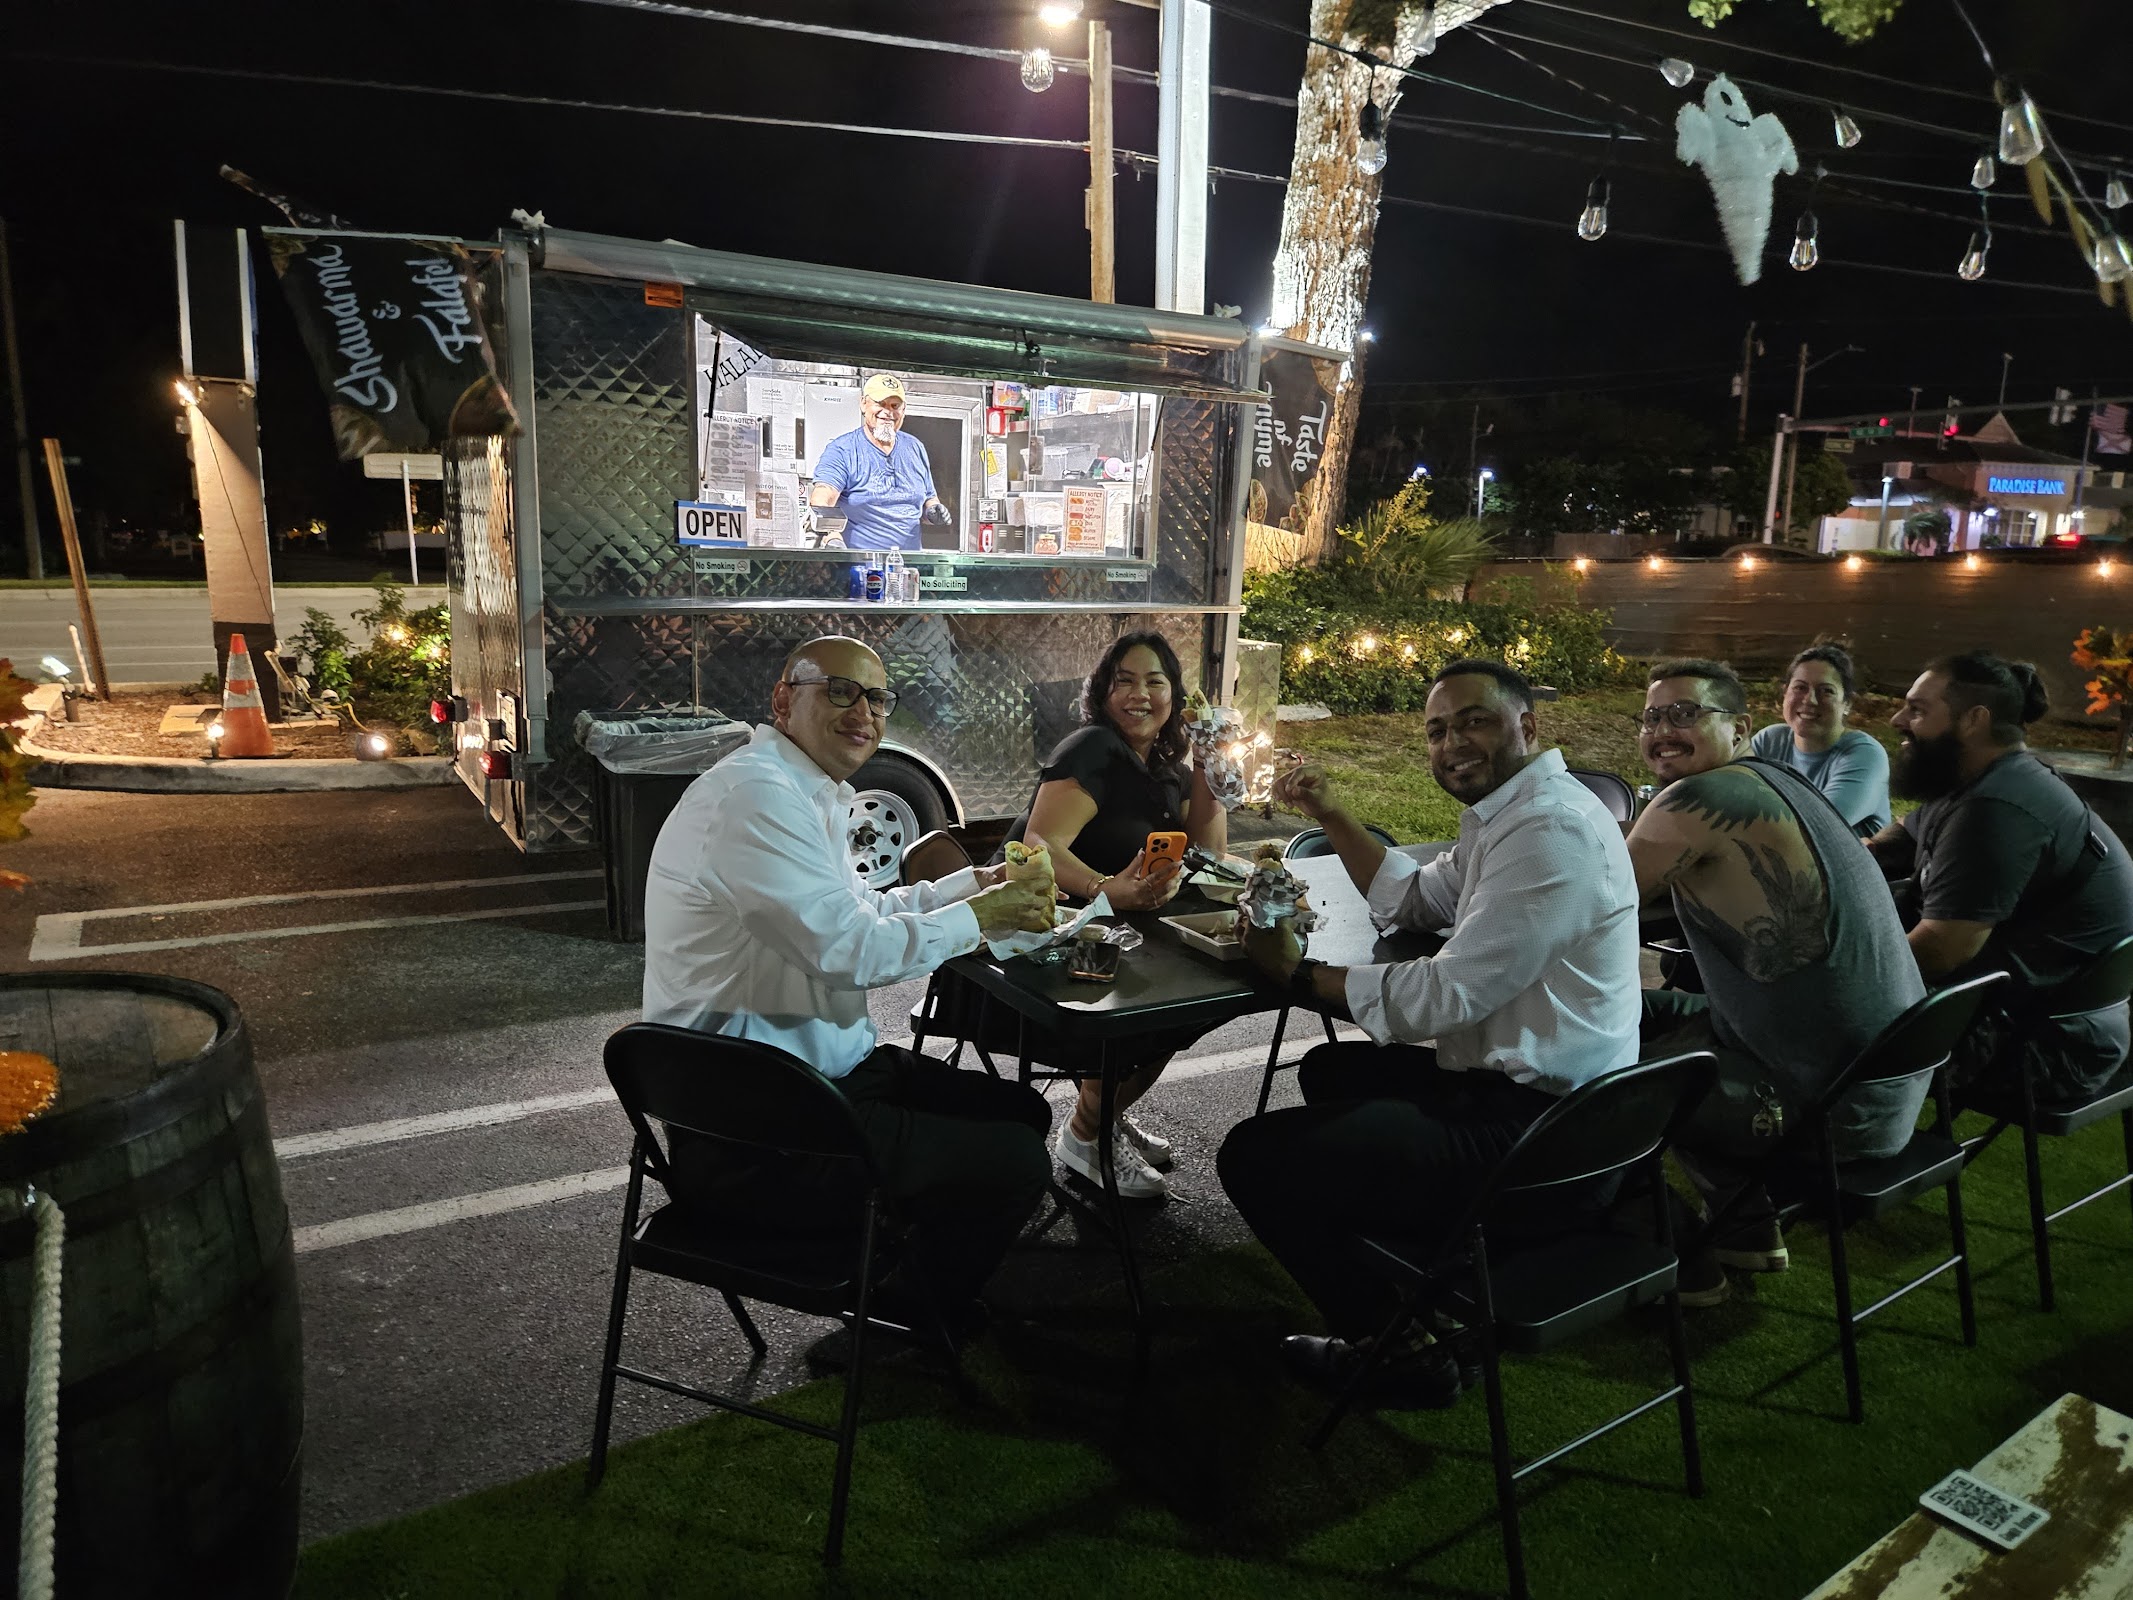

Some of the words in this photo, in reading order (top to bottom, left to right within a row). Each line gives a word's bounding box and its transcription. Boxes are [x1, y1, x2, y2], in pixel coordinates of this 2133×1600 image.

[371, 300, 401, 320] &
[403, 256, 481, 364] Falafel
[306, 244, 398, 413] Shawarma
[1273, 418, 1293, 447] of
[1290, 400, 1327, 472] Taste
[1988, 477, 2036, 494] PARADISE
[2036, 479, 2065, 495] BANK
[685, 509, 742, 538] OPEN
[695, 561, 705, 570] No
[706, 561, 735, 572] Smoking
[1115, 571, 1137, 580] Smoking
[921, 579, 931, 589] No
[932, 580, 966, 590] Soliciting
